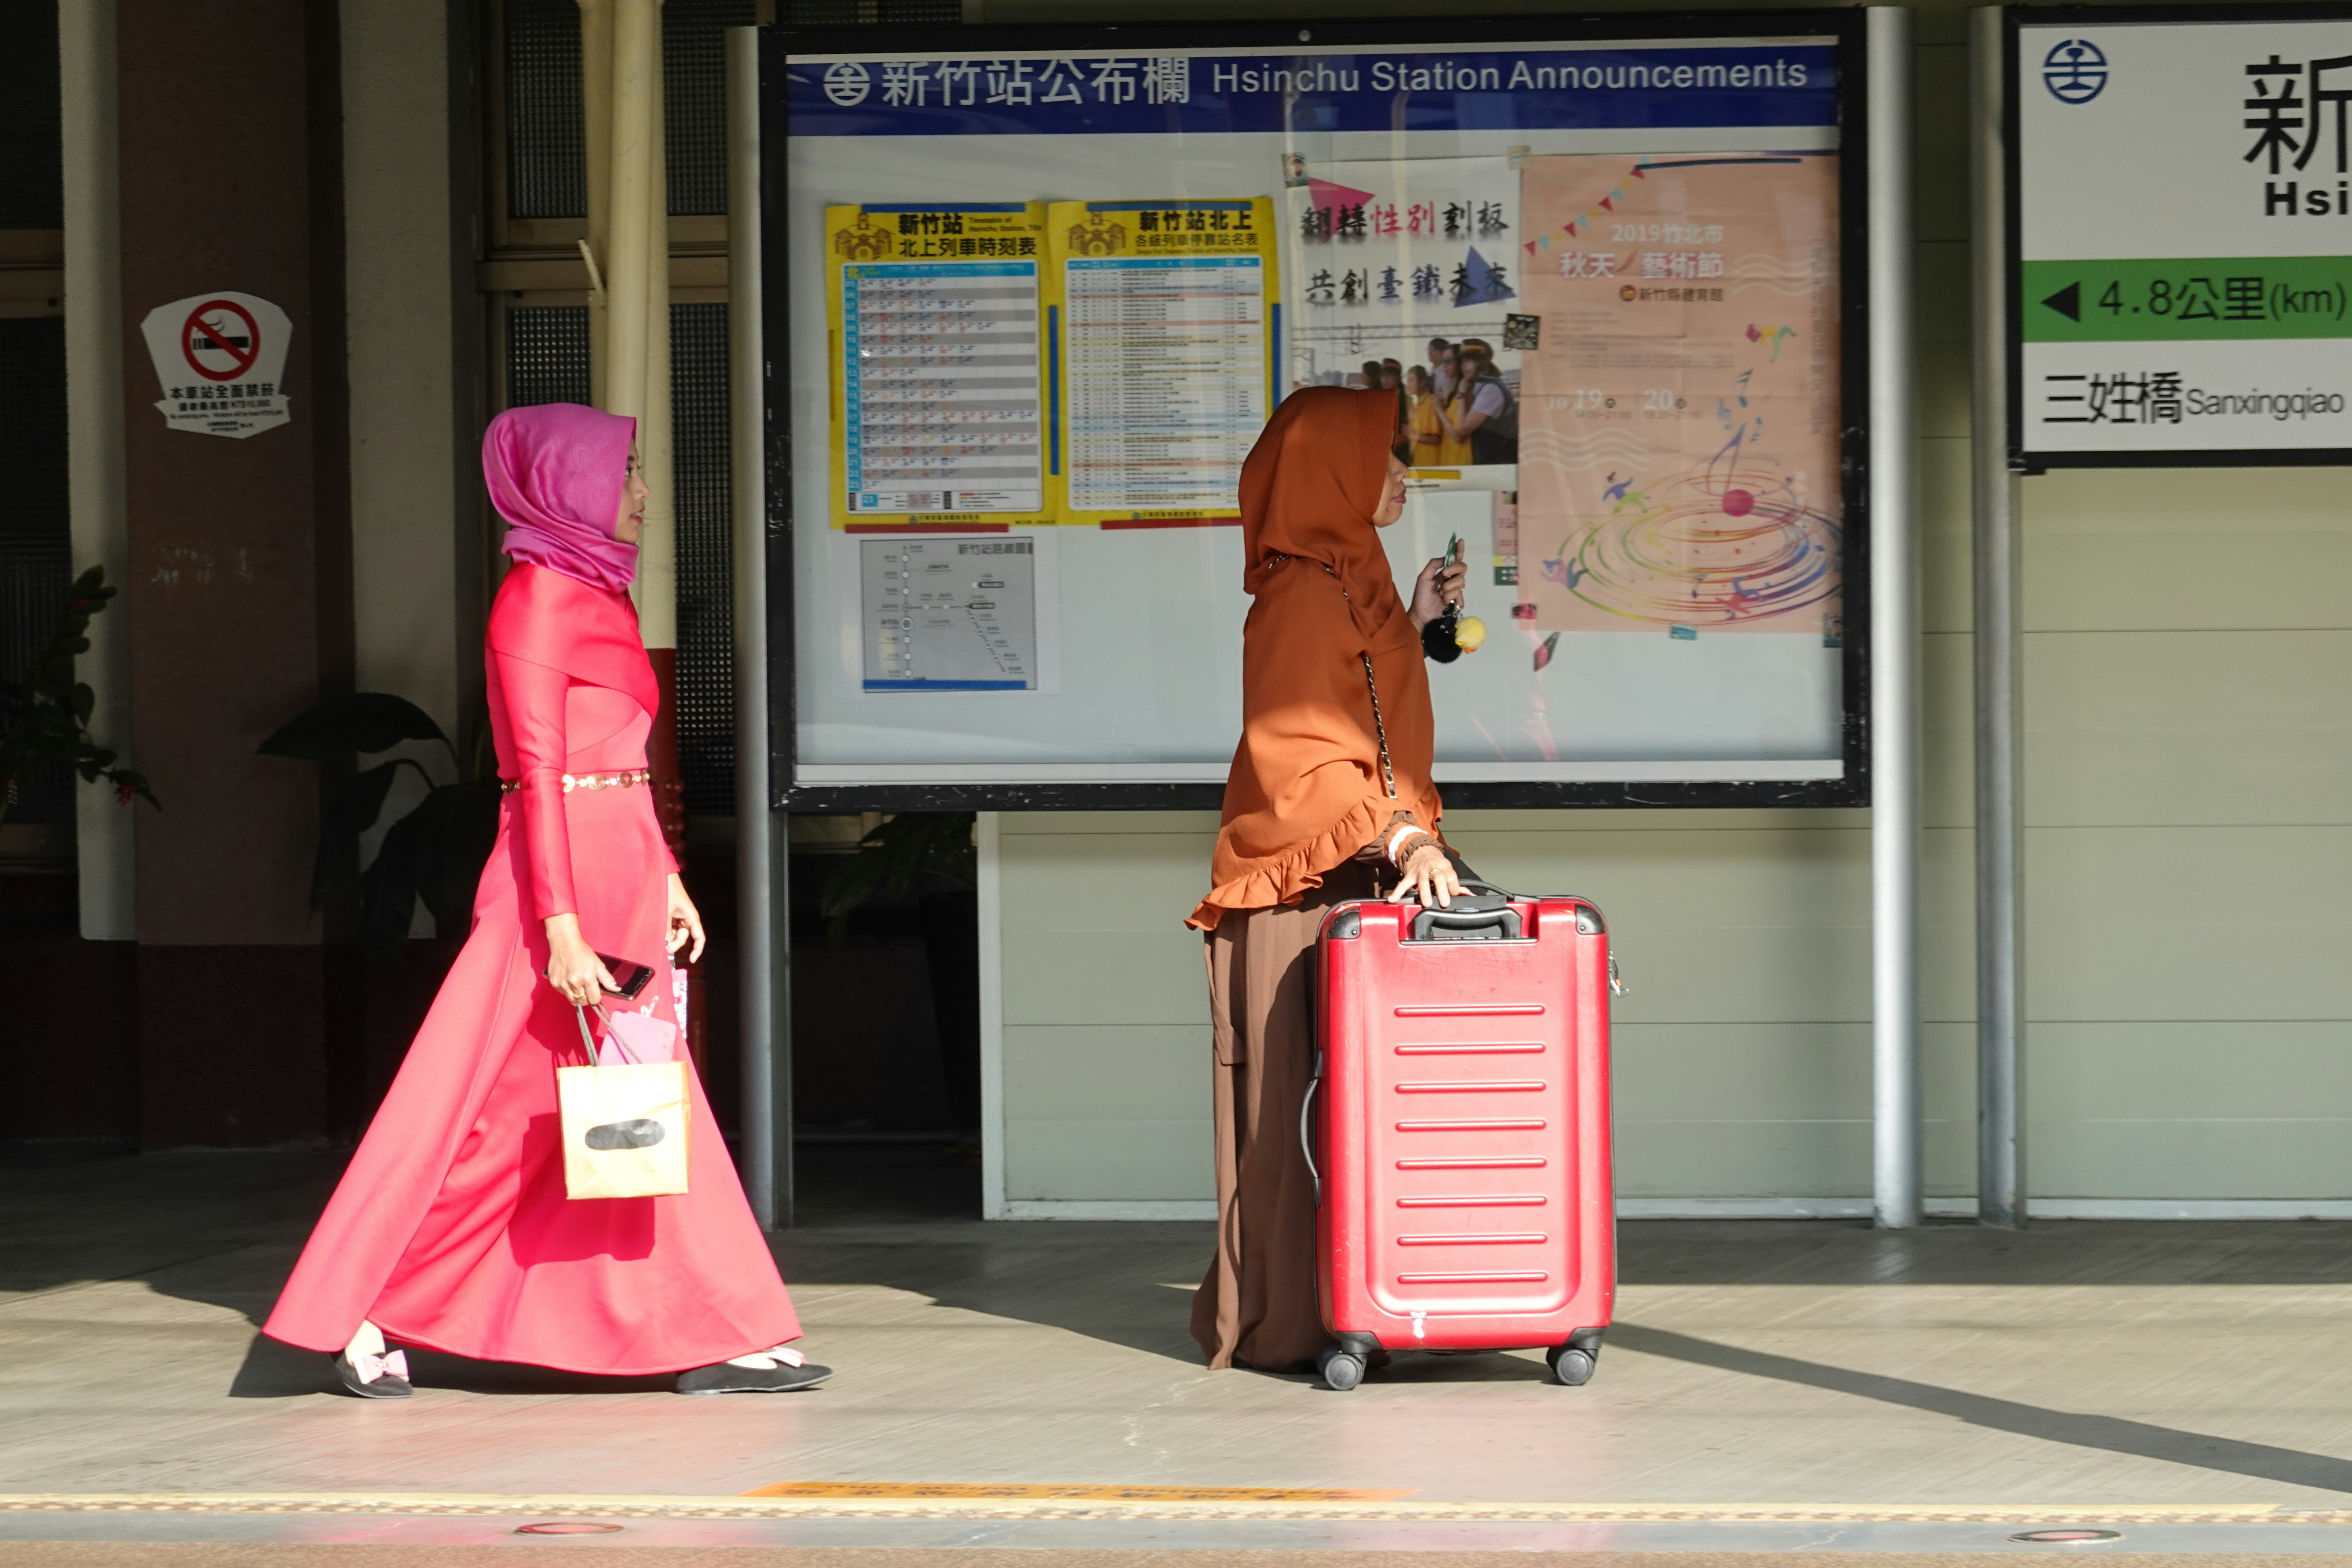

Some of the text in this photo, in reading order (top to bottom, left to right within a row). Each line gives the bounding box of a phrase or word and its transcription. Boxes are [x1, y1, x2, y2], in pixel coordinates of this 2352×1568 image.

[882, 57, 1808, 107] 新竹站公布欄 Hsinchu Station Announcements
[2243, 55, 2352, 174] 新
[2265, 181, 2349, 216] Hsi
[899, 213, 963, 235] 新竹站
[1139, 210, 1252, 231] 新竹站北上
[1611, 224, 1724, 244] 2019竹北市
[899, 237, 1036, 257] 北上列車時刻表
[1305, 262, 1513, 301] 共創臺鐵未來
[1559, 251, 1724, 280] 秋天 藝術節
[2098, 276, 2346, 322] 4.8公里(km)
[1643, 389, 1674, 410] 20
[2043, 371, 2344, 425] 三姓橋 Sanxingqiao
